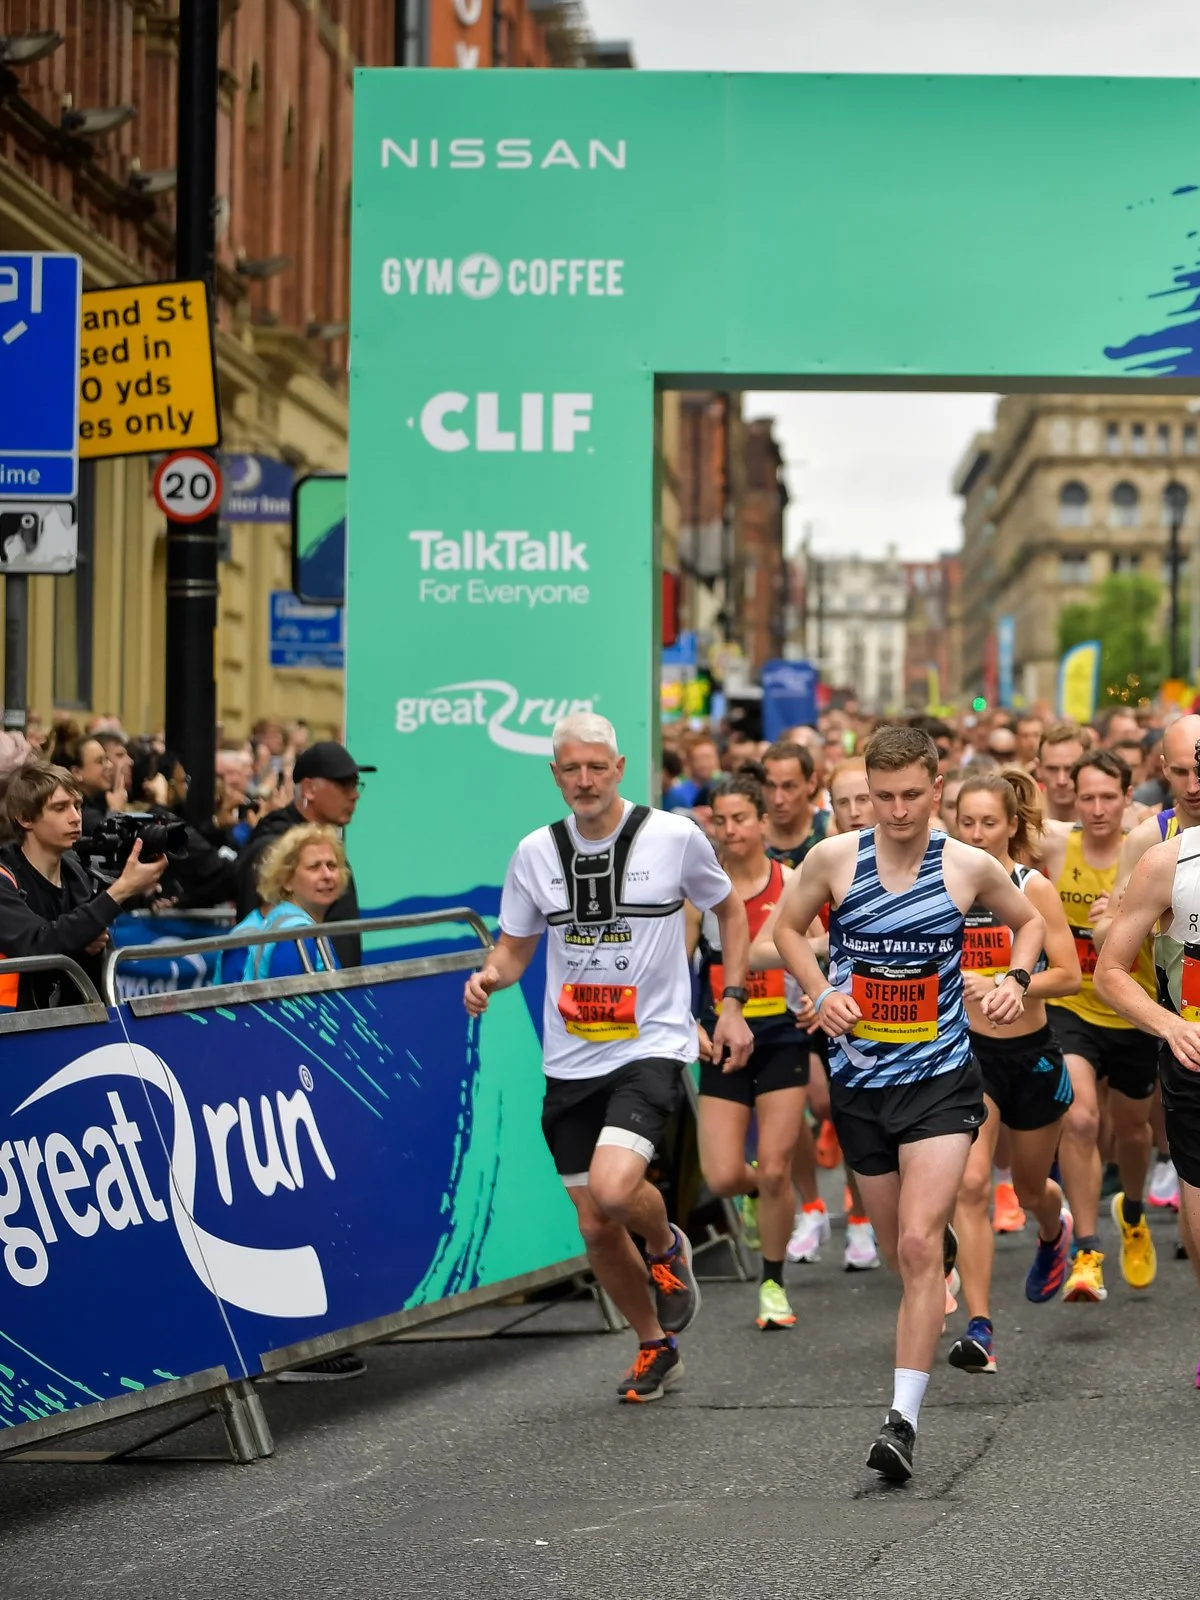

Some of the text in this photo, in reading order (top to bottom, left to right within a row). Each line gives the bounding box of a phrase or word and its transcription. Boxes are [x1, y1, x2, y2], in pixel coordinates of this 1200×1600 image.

[381, 138, 627, 169] NISSAN
[381, 258, 624, 296] GYM COFFEE
[157, 295, 193, 322] St
[144, 334, 171, 361] in
[116, 370, 171, 405] yds
[125, 404, 194, 436] only
[421, 391, 593, 452] CLIF
[165, 473, 211, 500] 20
[409, 530, 590, 571] TalkTalk
[418, 579, 590, 608] For Everyone
[395, 691, 488, 733] great
[843, 932, 954, 953] LAGAN VALLEY AC
[572, 986, 622, 1004] ANDREW
[865, 982, 925, 1001] STEPHEN
[871, 1003, 918, 1022] 23096
